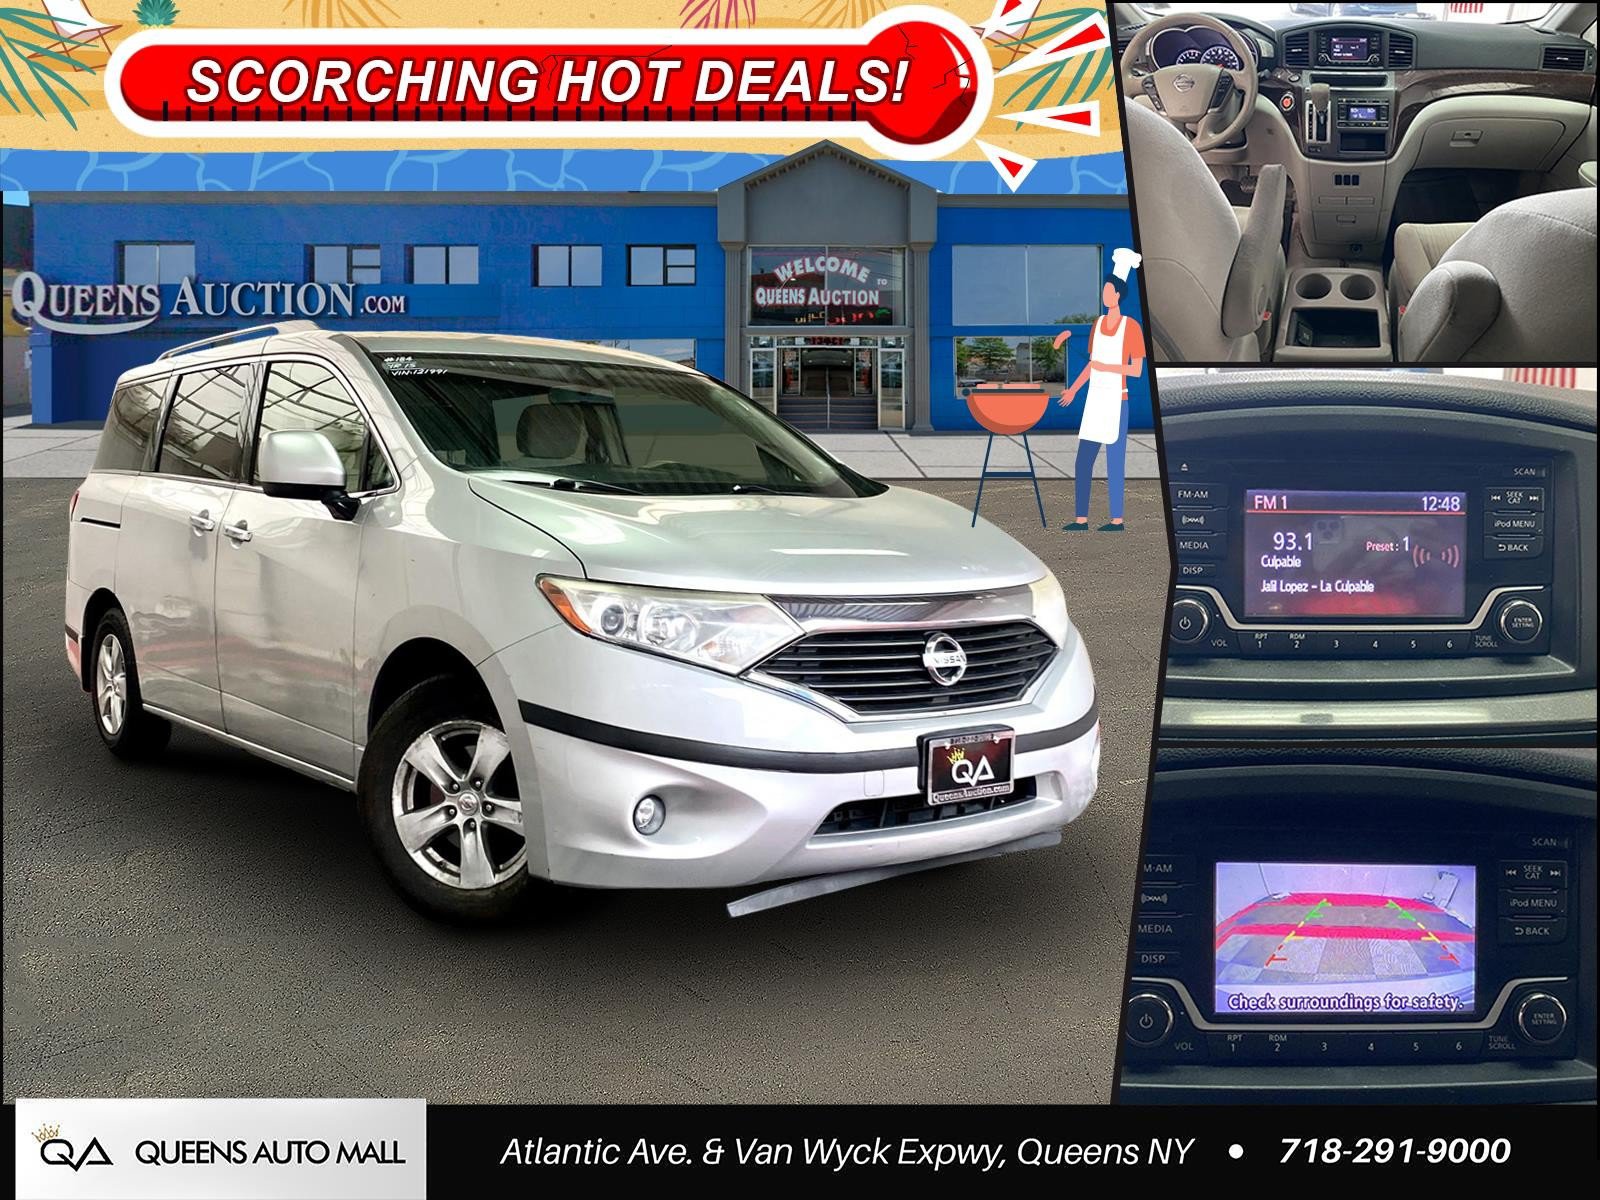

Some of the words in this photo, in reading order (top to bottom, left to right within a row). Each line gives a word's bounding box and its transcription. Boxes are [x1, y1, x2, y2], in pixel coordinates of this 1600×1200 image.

[773, 255, 871, 284] WELCOME
[876, 278, 888, 286] TO
[755, 286, 806, 306] QUEENS
[807, 287, 881, 306] AUCTION
[11, 271, 160, 334] QUEENS
[1513, 467, 1537, 476] SCAN
[1505, 490, 1524, 498] SEEK
[1254, 495, 1277, 510] FM
[1281, 495, 1288, 510] 1
[1421, 496, 1461, 512] 12:48
[1494, 520, 1511, 528] iPod
[1512, 520, 1536, 528] MENU
[1179, 541, 1210, 550] MEDIA
[1272, 532, 1313, 551] 93.1
[1402, 536, 1410, 552] 1
[1507, 544, 1529, 552] BACK
[1260, 555, 1302, 568] Culpable
[1182, 566, 1204, 575] DISP
[1280, 580, 1309, 595] Lopez
[1320, 580, 1333, 592] La
[1335, 580, 1375, 594] Culpable
[1210, 639, 1228, 647] VOL
[1294, 641, 1300, 649] 2
[1333, 640, 1340, 649] 3
[1372, 640, 1379, 648] 4
[1410, 640, 1417, 648] 5
[1446, 640, 1453, 649] 6
[1531, 837, 1557, 846] SCAN
[1523, 865, 1543, 873] SEEK
[1510, 899, 1529, 907] iPod
[1530, 899, 1558, 907] MENU
[1138, 924, 1173, 934] MEDIA
[1525, 927, 1550, 936] BACK
[1141, 954, 1166, 964] DISP
[1228, 993, 1276, 1010] Check
[1279, 993, 1380, 1013] surroundings
[1384, 993, 1407, 1010] for
[1411, 993, 1464, 1012] safety.
[1227, 1034, 1243, 1042] RPT
[1268, 1034, 1288, 1042] RDM
[1174, 1042, 1194, 1051] VOL
[1274, 1043, 1281, 1051] 2
[1321, 1042, 1328, 1051] 3
[1367, 1042, 1374, 1051] 4
[1413, 1042, 1419, 1051] 5
[1455, 1041, 1463, 1051] 6
